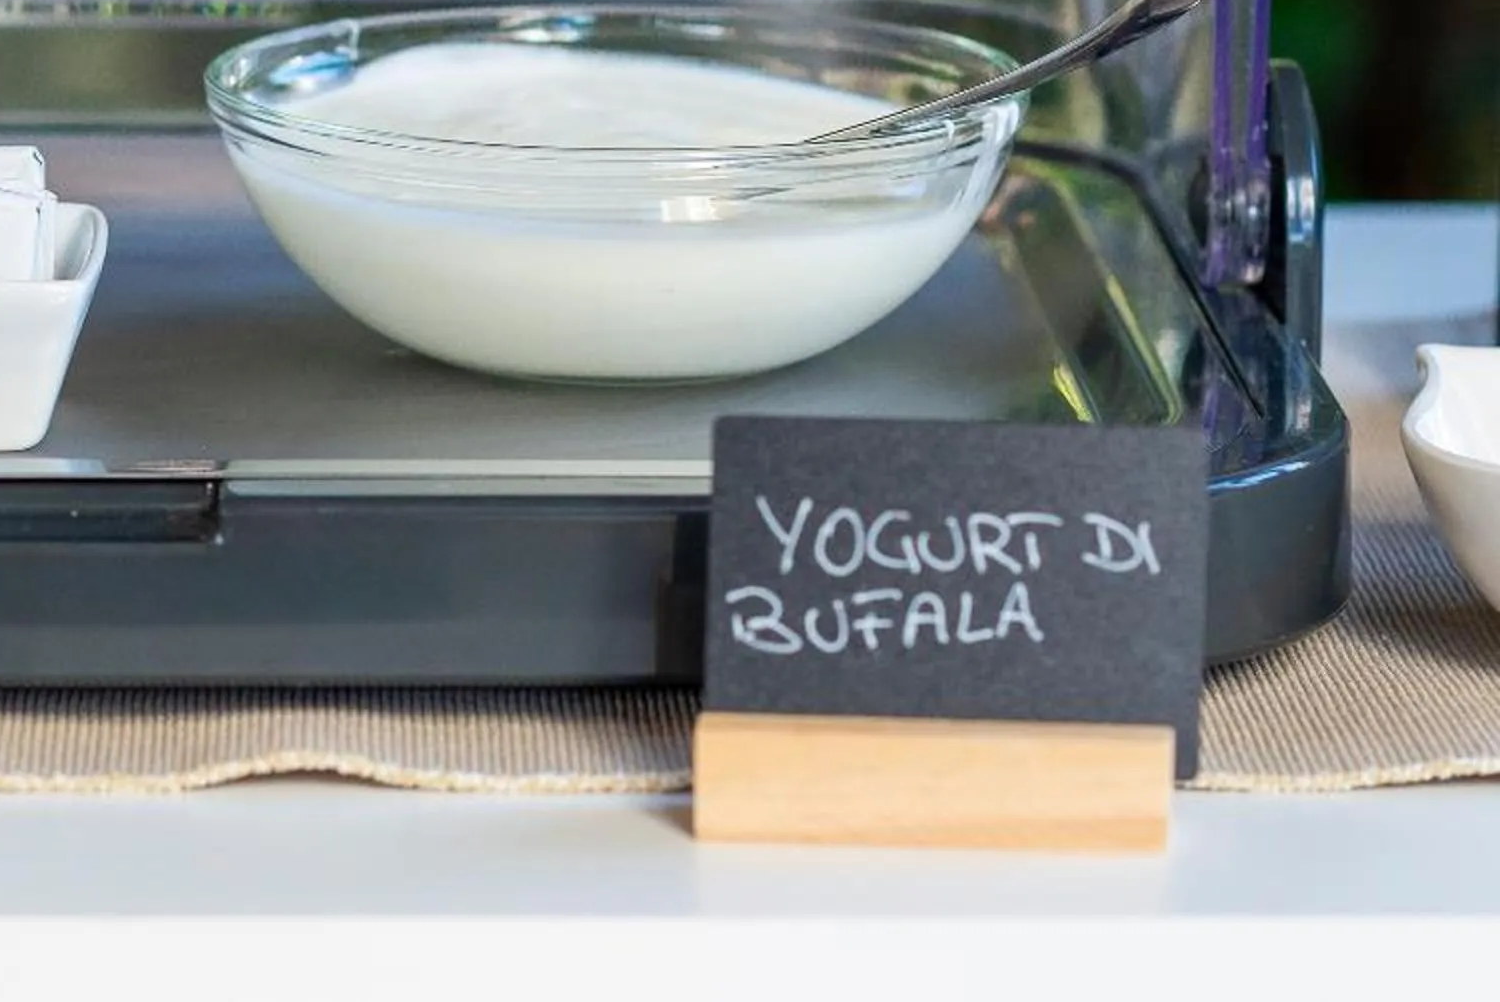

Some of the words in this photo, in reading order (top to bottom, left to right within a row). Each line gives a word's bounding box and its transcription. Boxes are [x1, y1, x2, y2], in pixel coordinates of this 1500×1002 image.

[756, 496, 1064, 577] YOGURT
[1082, 513, 1161, 575] DI
[725, 582, 1044, 654] BUFALA
